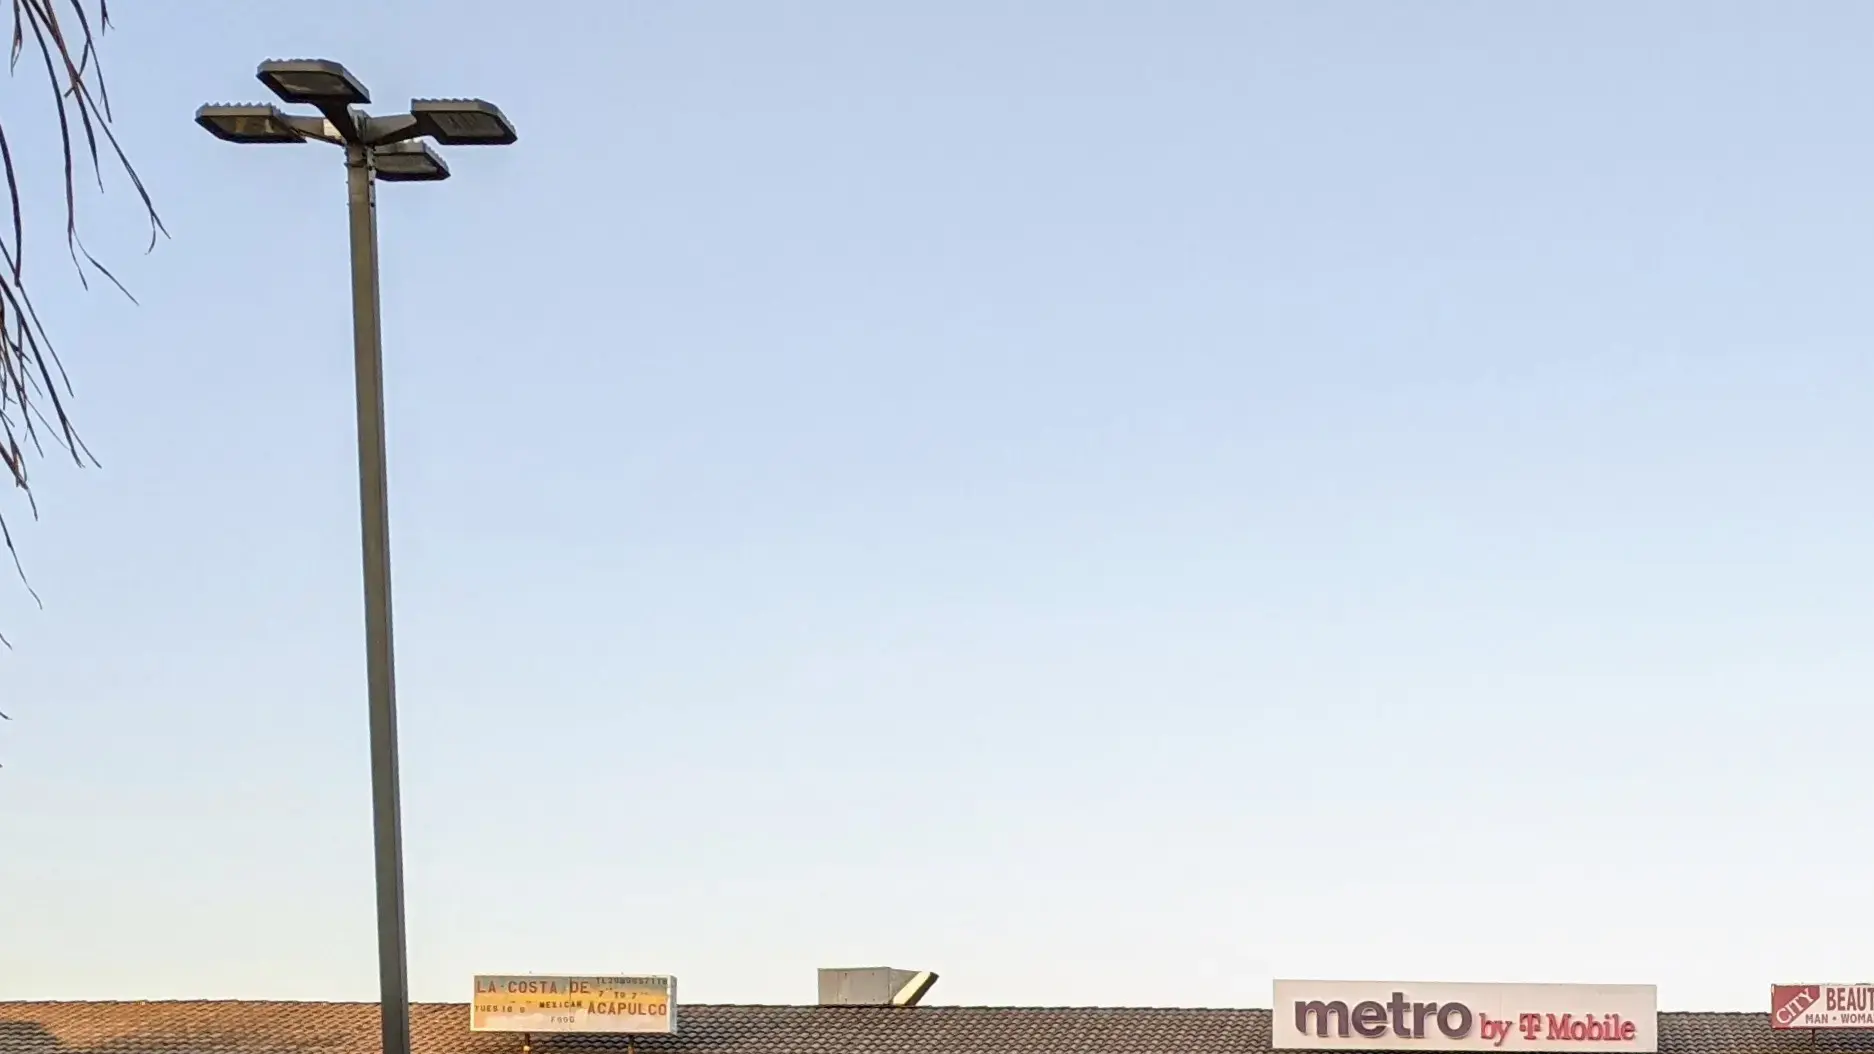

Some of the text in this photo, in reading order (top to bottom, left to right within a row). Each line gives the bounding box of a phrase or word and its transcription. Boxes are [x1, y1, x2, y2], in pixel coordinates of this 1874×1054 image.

[477, 980, 590, 994] LA COSTA DE
[539, 1000, 583, 1009] MEXICAN
[587, 1003, 668, 1016] ACAPULCO
[1776, 987, 1814, 1024] CITY
[1294, 991, 1473, 1040] metro
[1480, 1012, 1512, 1047] by
[1546, 1013, 1636, 1041] Mobile
[1805, 1013, 1829, 1024] MAN
